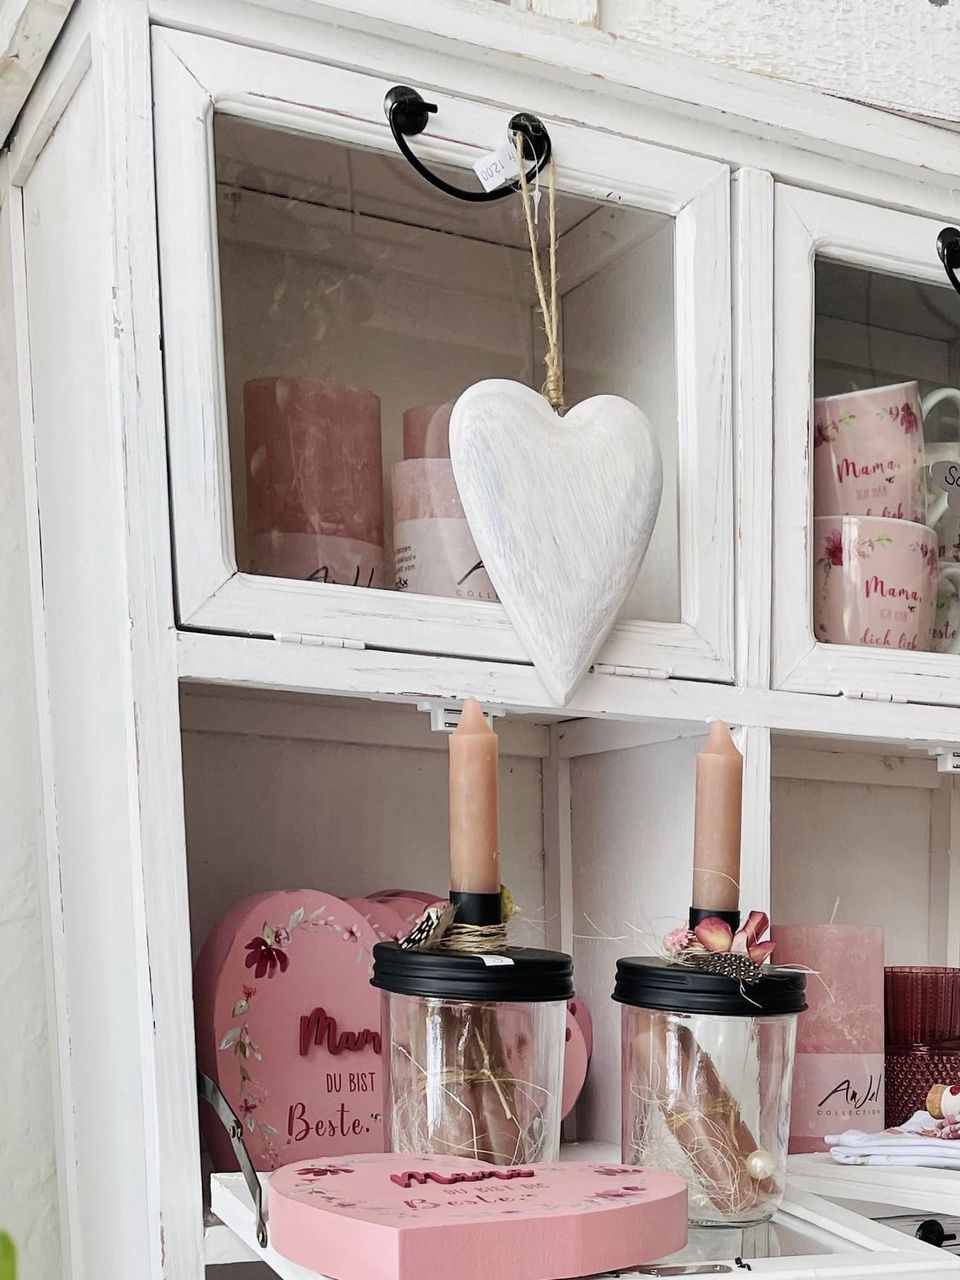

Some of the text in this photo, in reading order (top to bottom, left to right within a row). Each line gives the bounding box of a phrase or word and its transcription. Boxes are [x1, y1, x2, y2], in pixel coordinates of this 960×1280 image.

[860, 627, 892, 647] dich
[299, 1006, 382, 1057] Mam
[326, 1072, 376, 1093] DU BIST
[287, 1102, 371, 1142] Beste.
[390, 1168, 535, 1188] Mama
